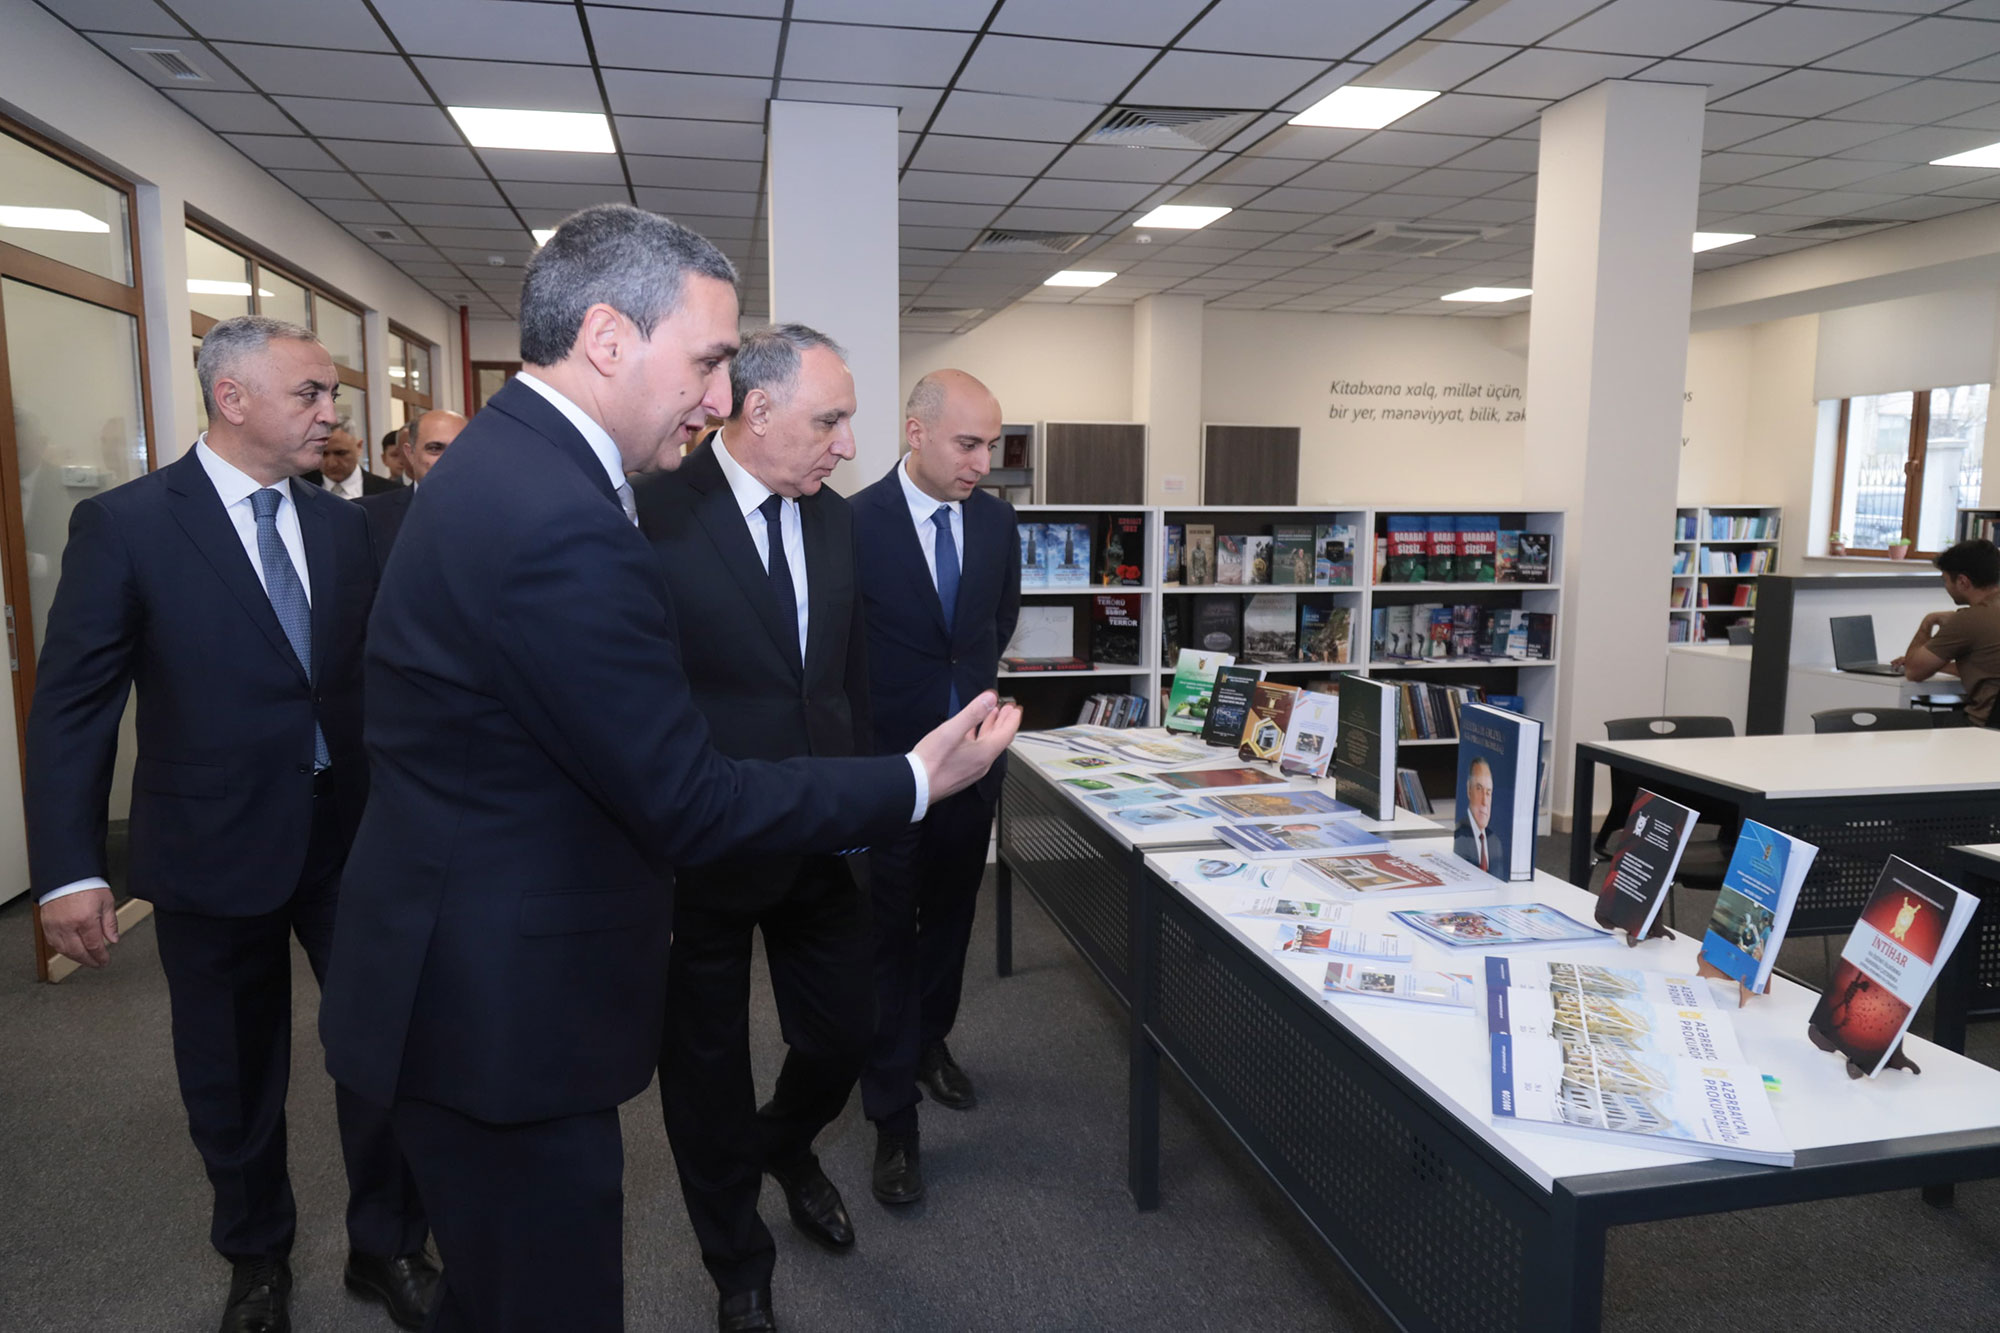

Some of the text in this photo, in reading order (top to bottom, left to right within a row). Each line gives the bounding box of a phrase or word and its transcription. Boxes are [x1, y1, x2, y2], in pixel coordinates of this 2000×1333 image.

[1330, 380, 1401, 395] Kitabxana
[1406, 382, 1437, 400] xalq,
[1443, 383, 1482, 397] millət
[1486, 384, 1522, 401] üçün,
[1329, 404, 1349, 419] bir
[1352, 408, 1376, 423] yer,
[1382, 406, 1464, 425] mənəviyyat,
[1470, 407, 1500, 423] bilik,
[1872, 934, 1909, 967] İNTİHAR
[1720, 1080, 1751, 1136] AZƏRBAYCAN
